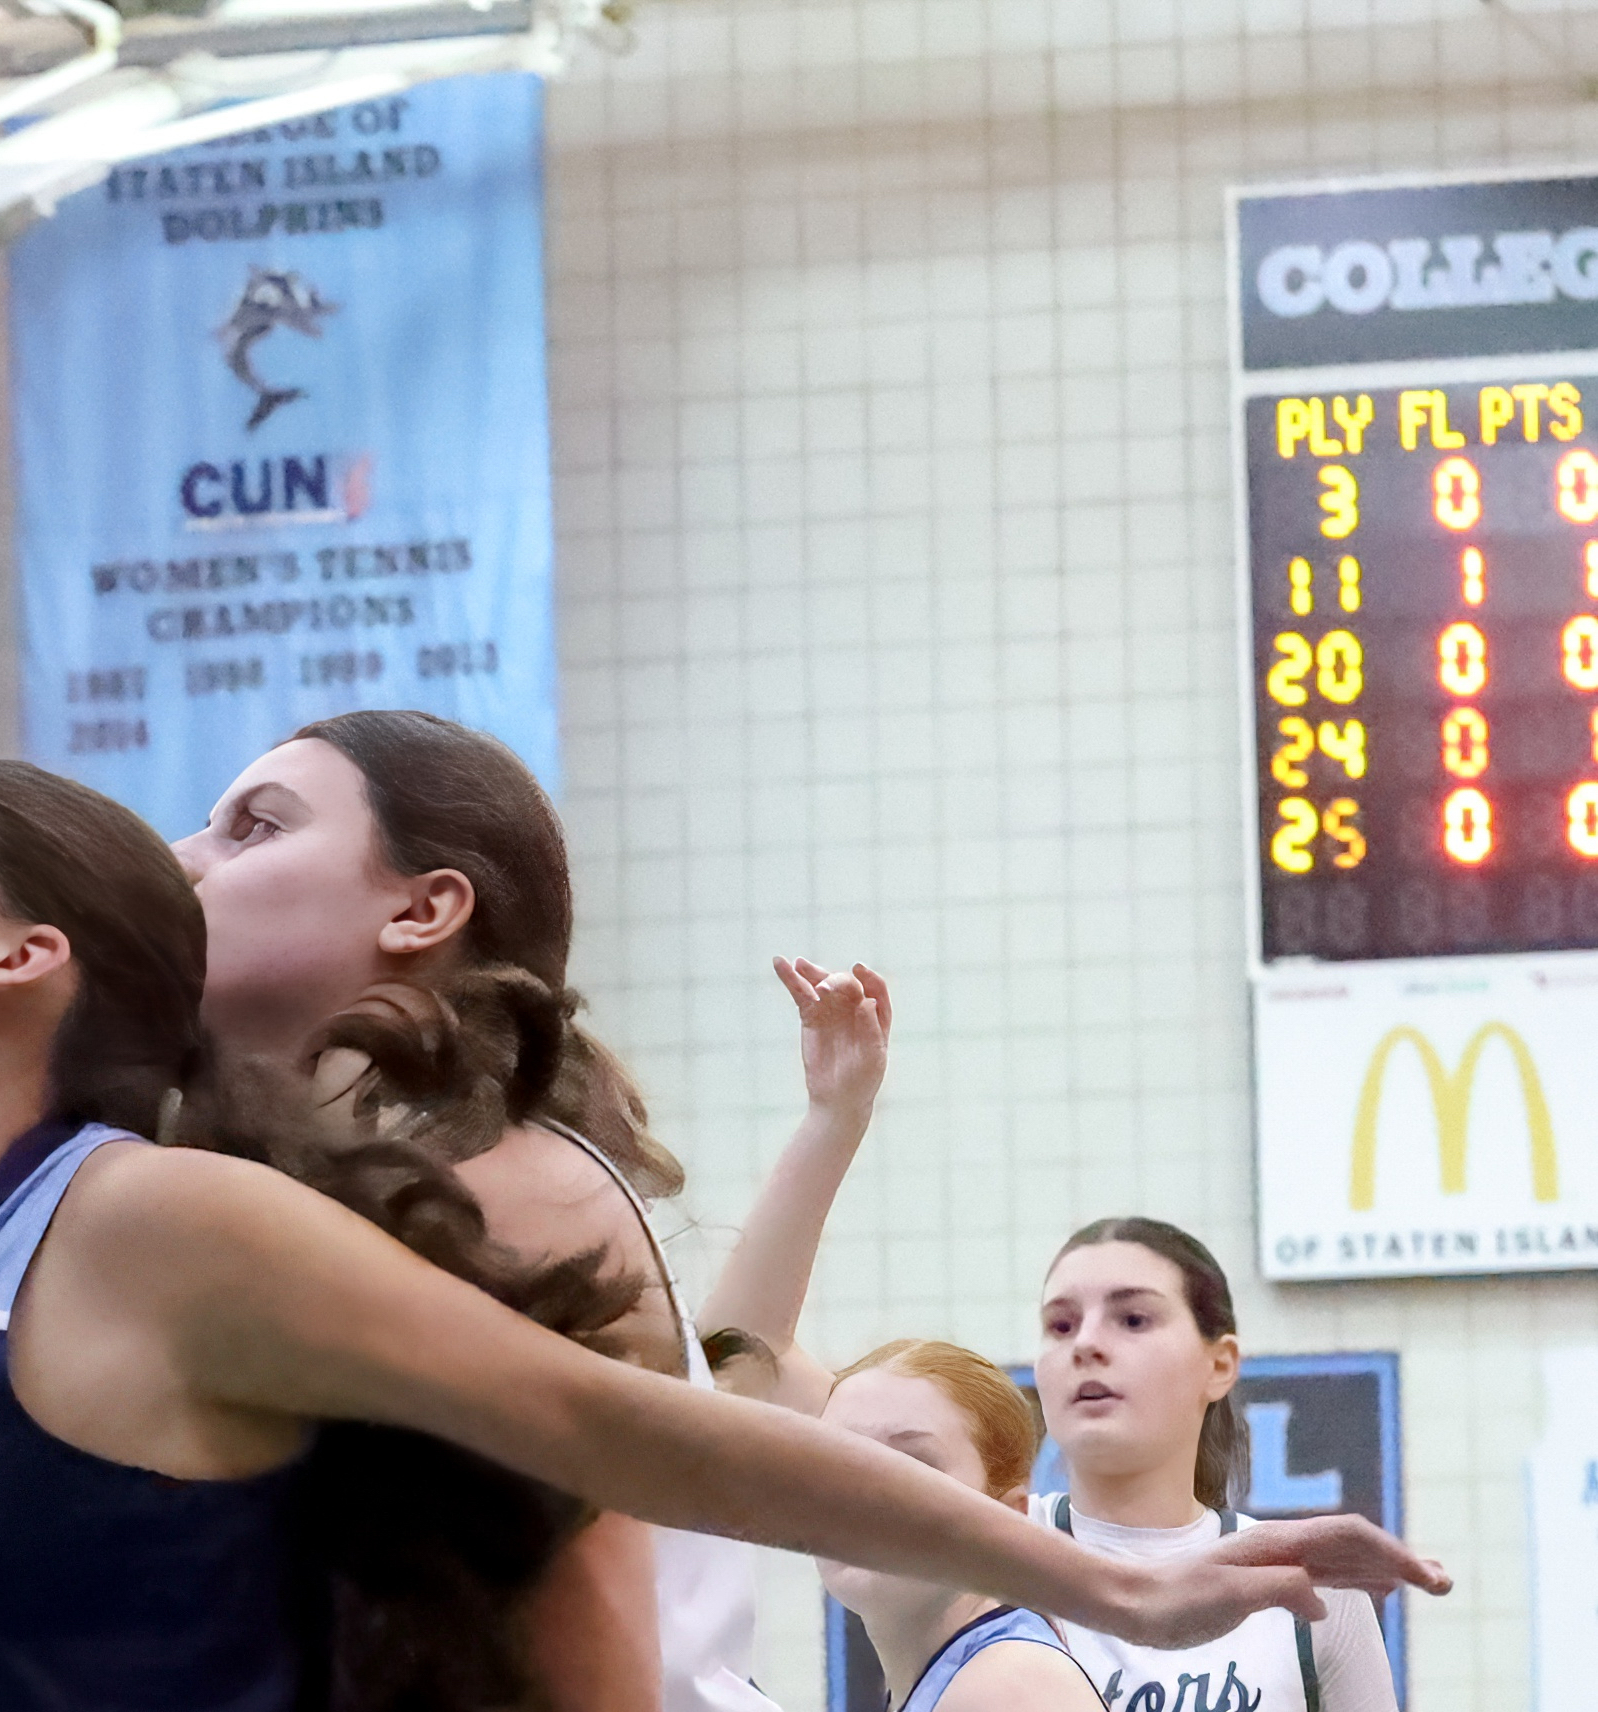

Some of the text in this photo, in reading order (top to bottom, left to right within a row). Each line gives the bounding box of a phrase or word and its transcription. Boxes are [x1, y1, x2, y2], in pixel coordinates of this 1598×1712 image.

[1276, 382, 1582, 458] PLY FL PTS
[1318, 464, 1359, 538] 3
[1432, 456, 1482, 532] 0
[1288, 556, 1361, 616] 11
[1460, 546, 1486, 606] 1
[1267, 630, 1363, 706] 20
[1436, 620, 1489, 697] 0
[1270, 705, 1491, 789] 24 0
[1270, 796, 1367, 874] 25
[1441, 786, 1494, 866] 0
[1275, 1232, 1321, 1266] OF
[1338, 1228, 1479, 1260] STATEN
